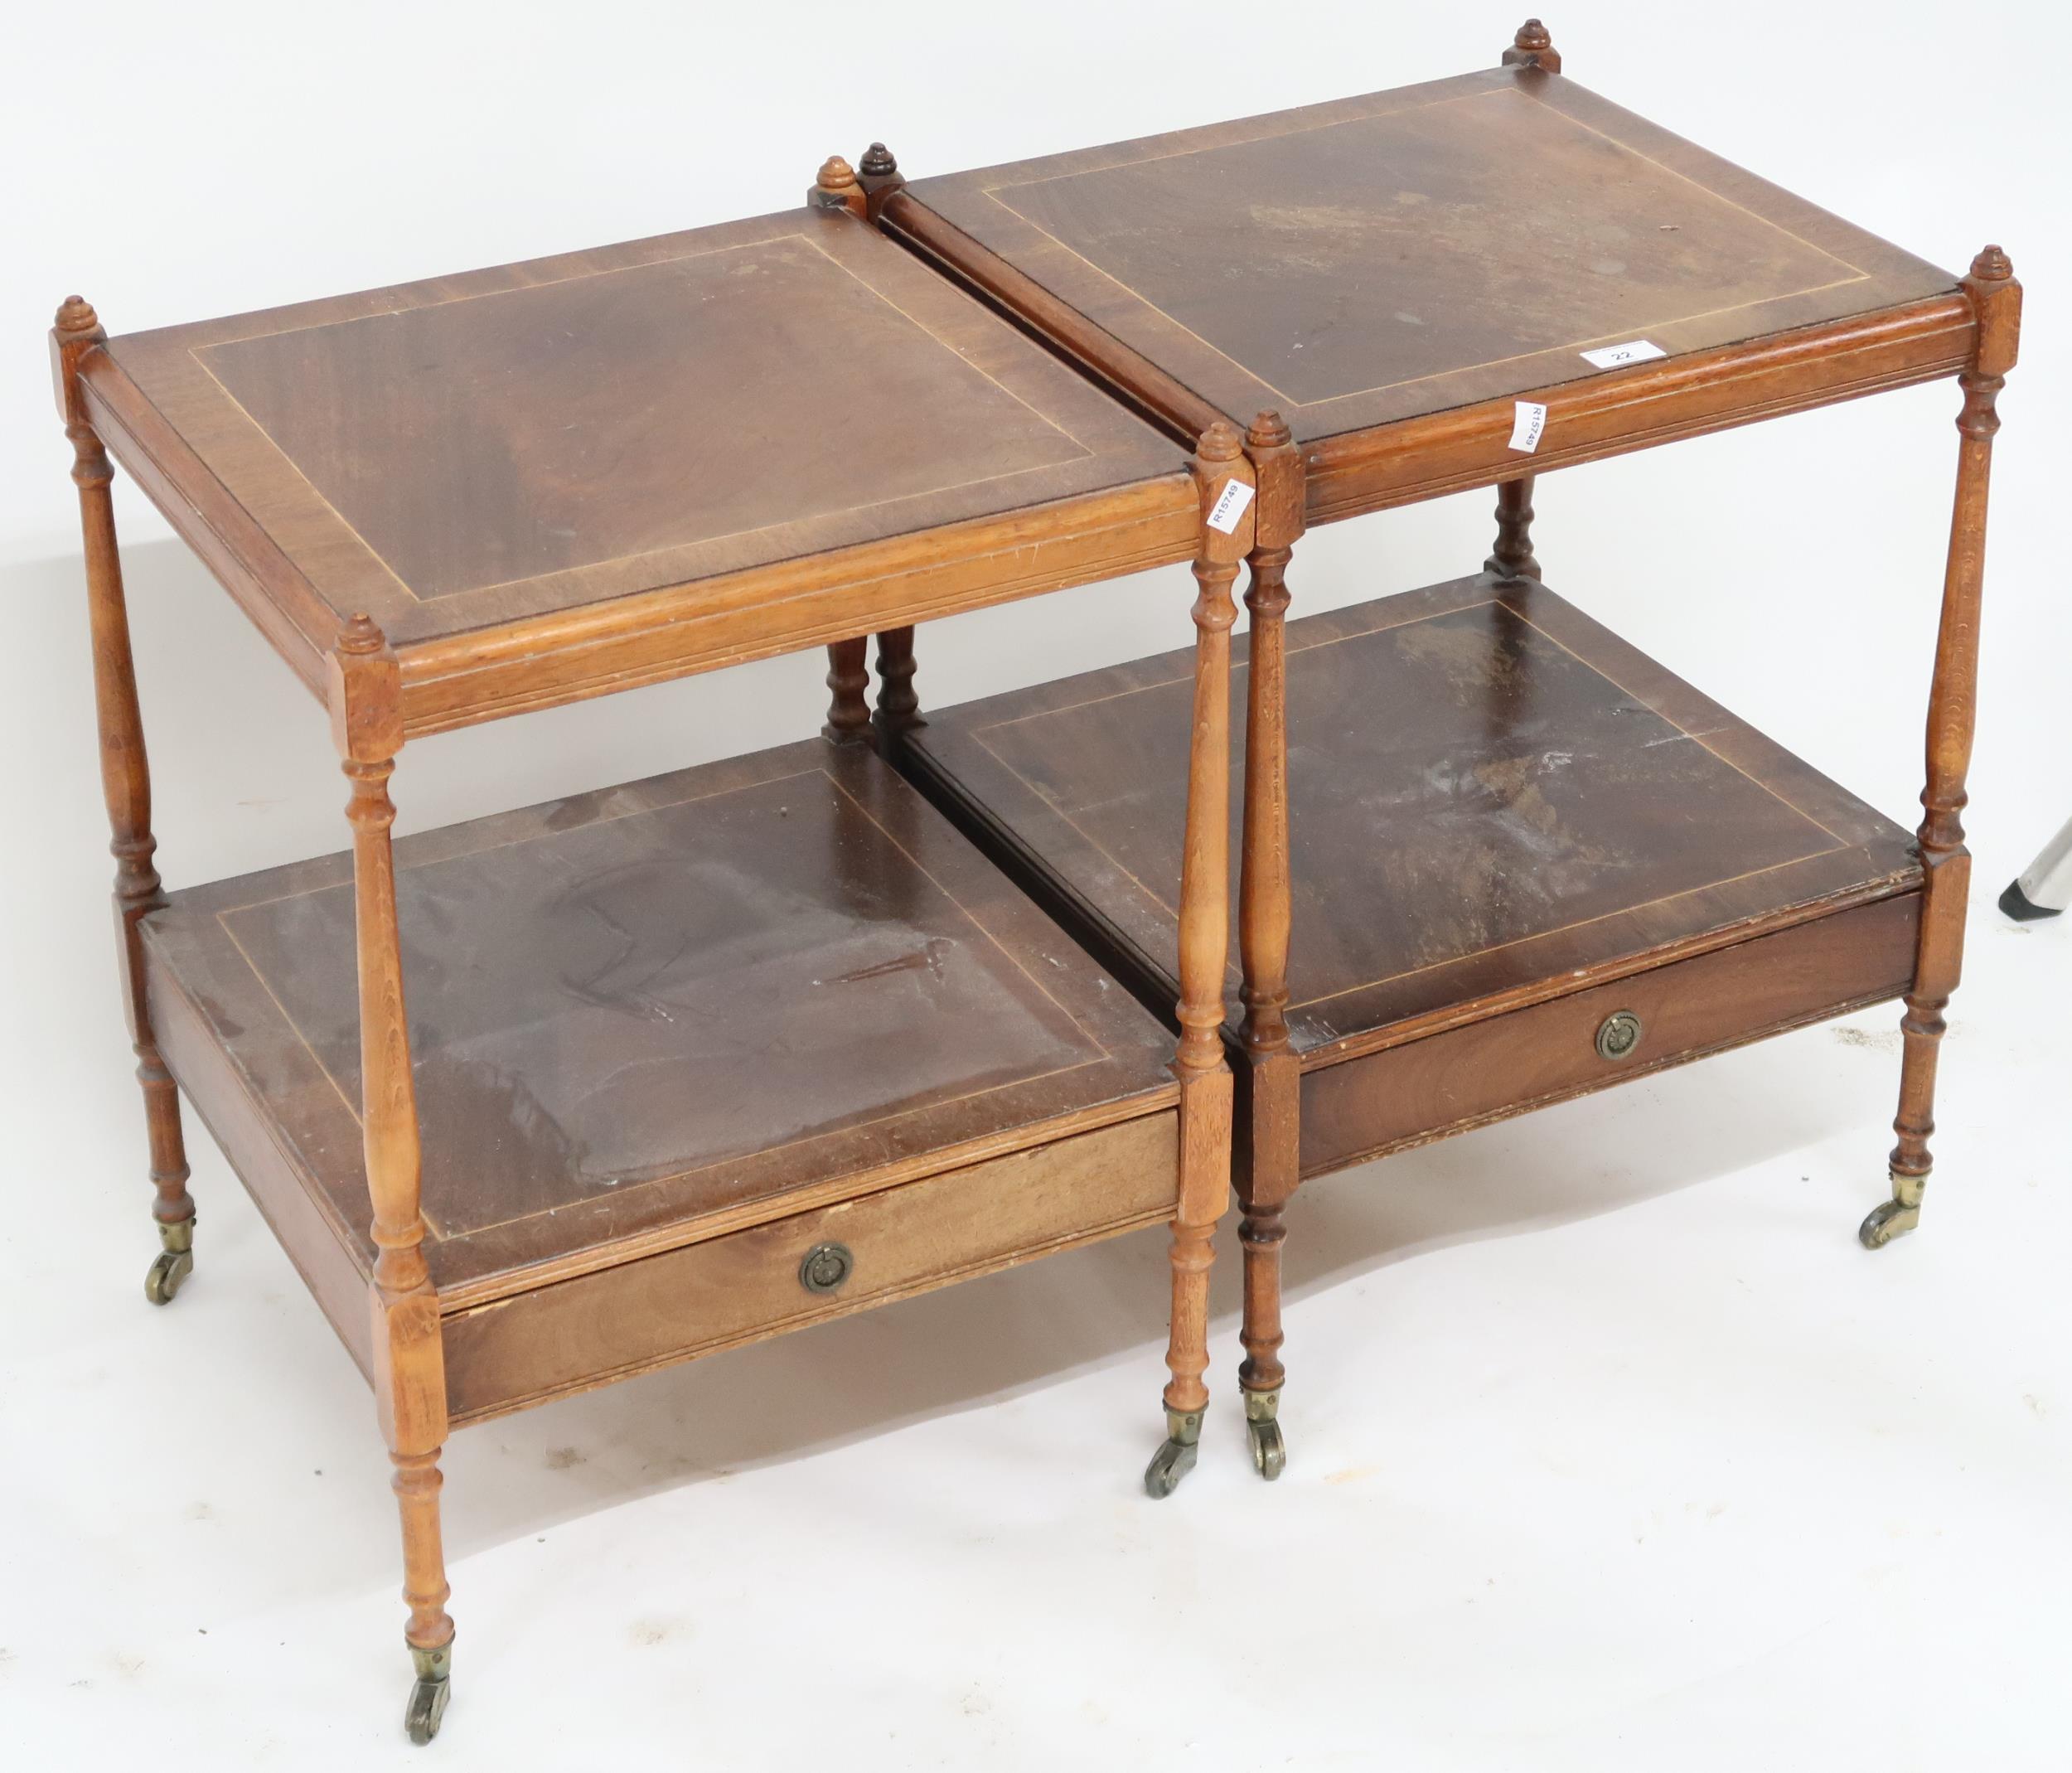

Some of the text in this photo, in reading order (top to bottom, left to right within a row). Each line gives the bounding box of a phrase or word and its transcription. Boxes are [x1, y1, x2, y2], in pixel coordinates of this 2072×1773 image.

[1610, 351, 1634, 361] 22
[1526, 407, 1542, 445] R15749
[1213, 485, 1238, 522] R15749
